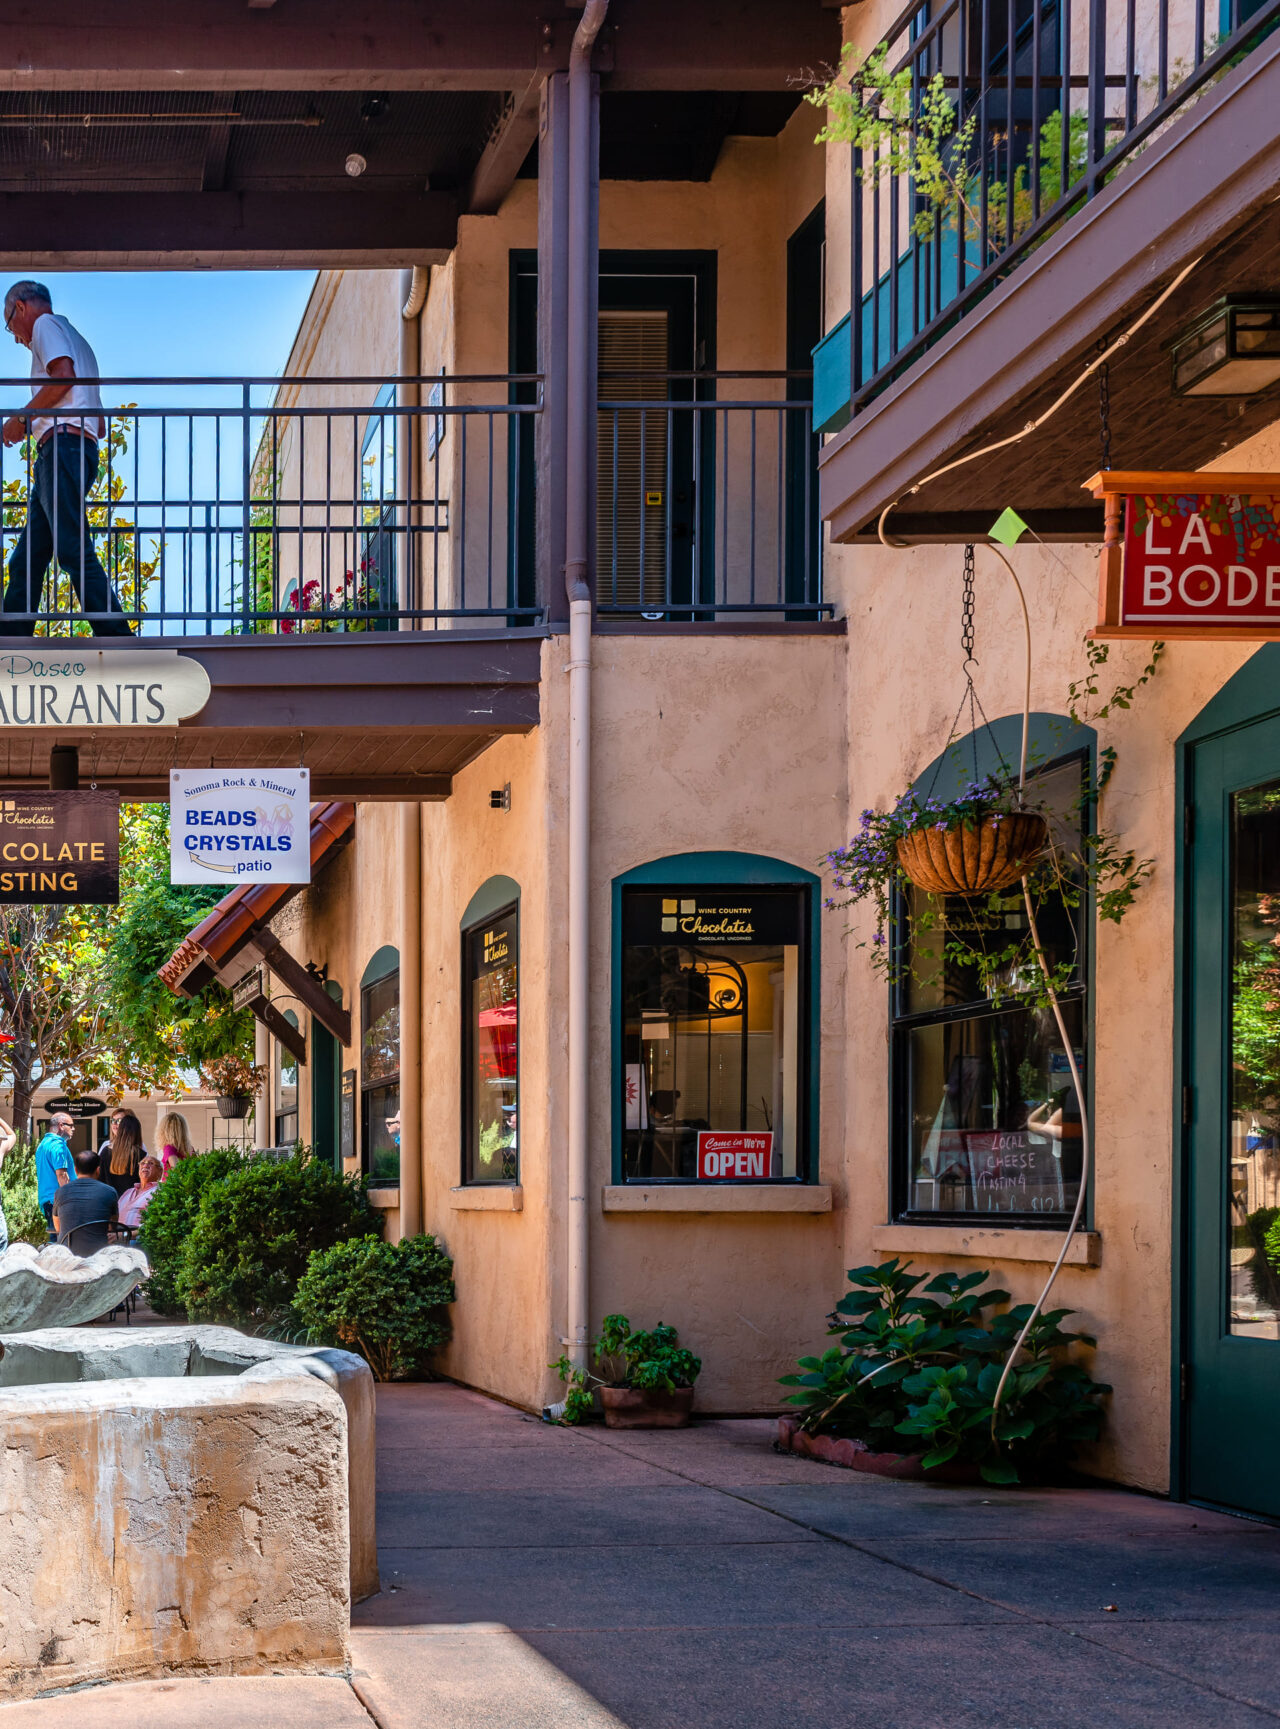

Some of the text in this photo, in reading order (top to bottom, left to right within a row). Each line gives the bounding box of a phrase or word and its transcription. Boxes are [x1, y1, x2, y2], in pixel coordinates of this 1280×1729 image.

[1145, 513, 1213, 555] LA
[1143, 564, 1280, 607] BODE
[0, 655, 86, 678] Paseo
[183, 778, 297, 798] Sonoma Rock & Mineral
[4, 812, 56, 825] Chocolates
[185, 809, 257, 827] BEADS
[184, 834, 292, 851] CRYSTALS
[237, 860, 272, 875] patio
[679, 916, 755, 934] Chocolates
[704, 1138, 732, 1150] Come
[744, 1138, 766, 1149] We're
[992, 1135, 1025, 1150] LOCAL
[704, 1152, 764, 1177] OPEN
[987, 1152, 1036, 1168] CHEESE
